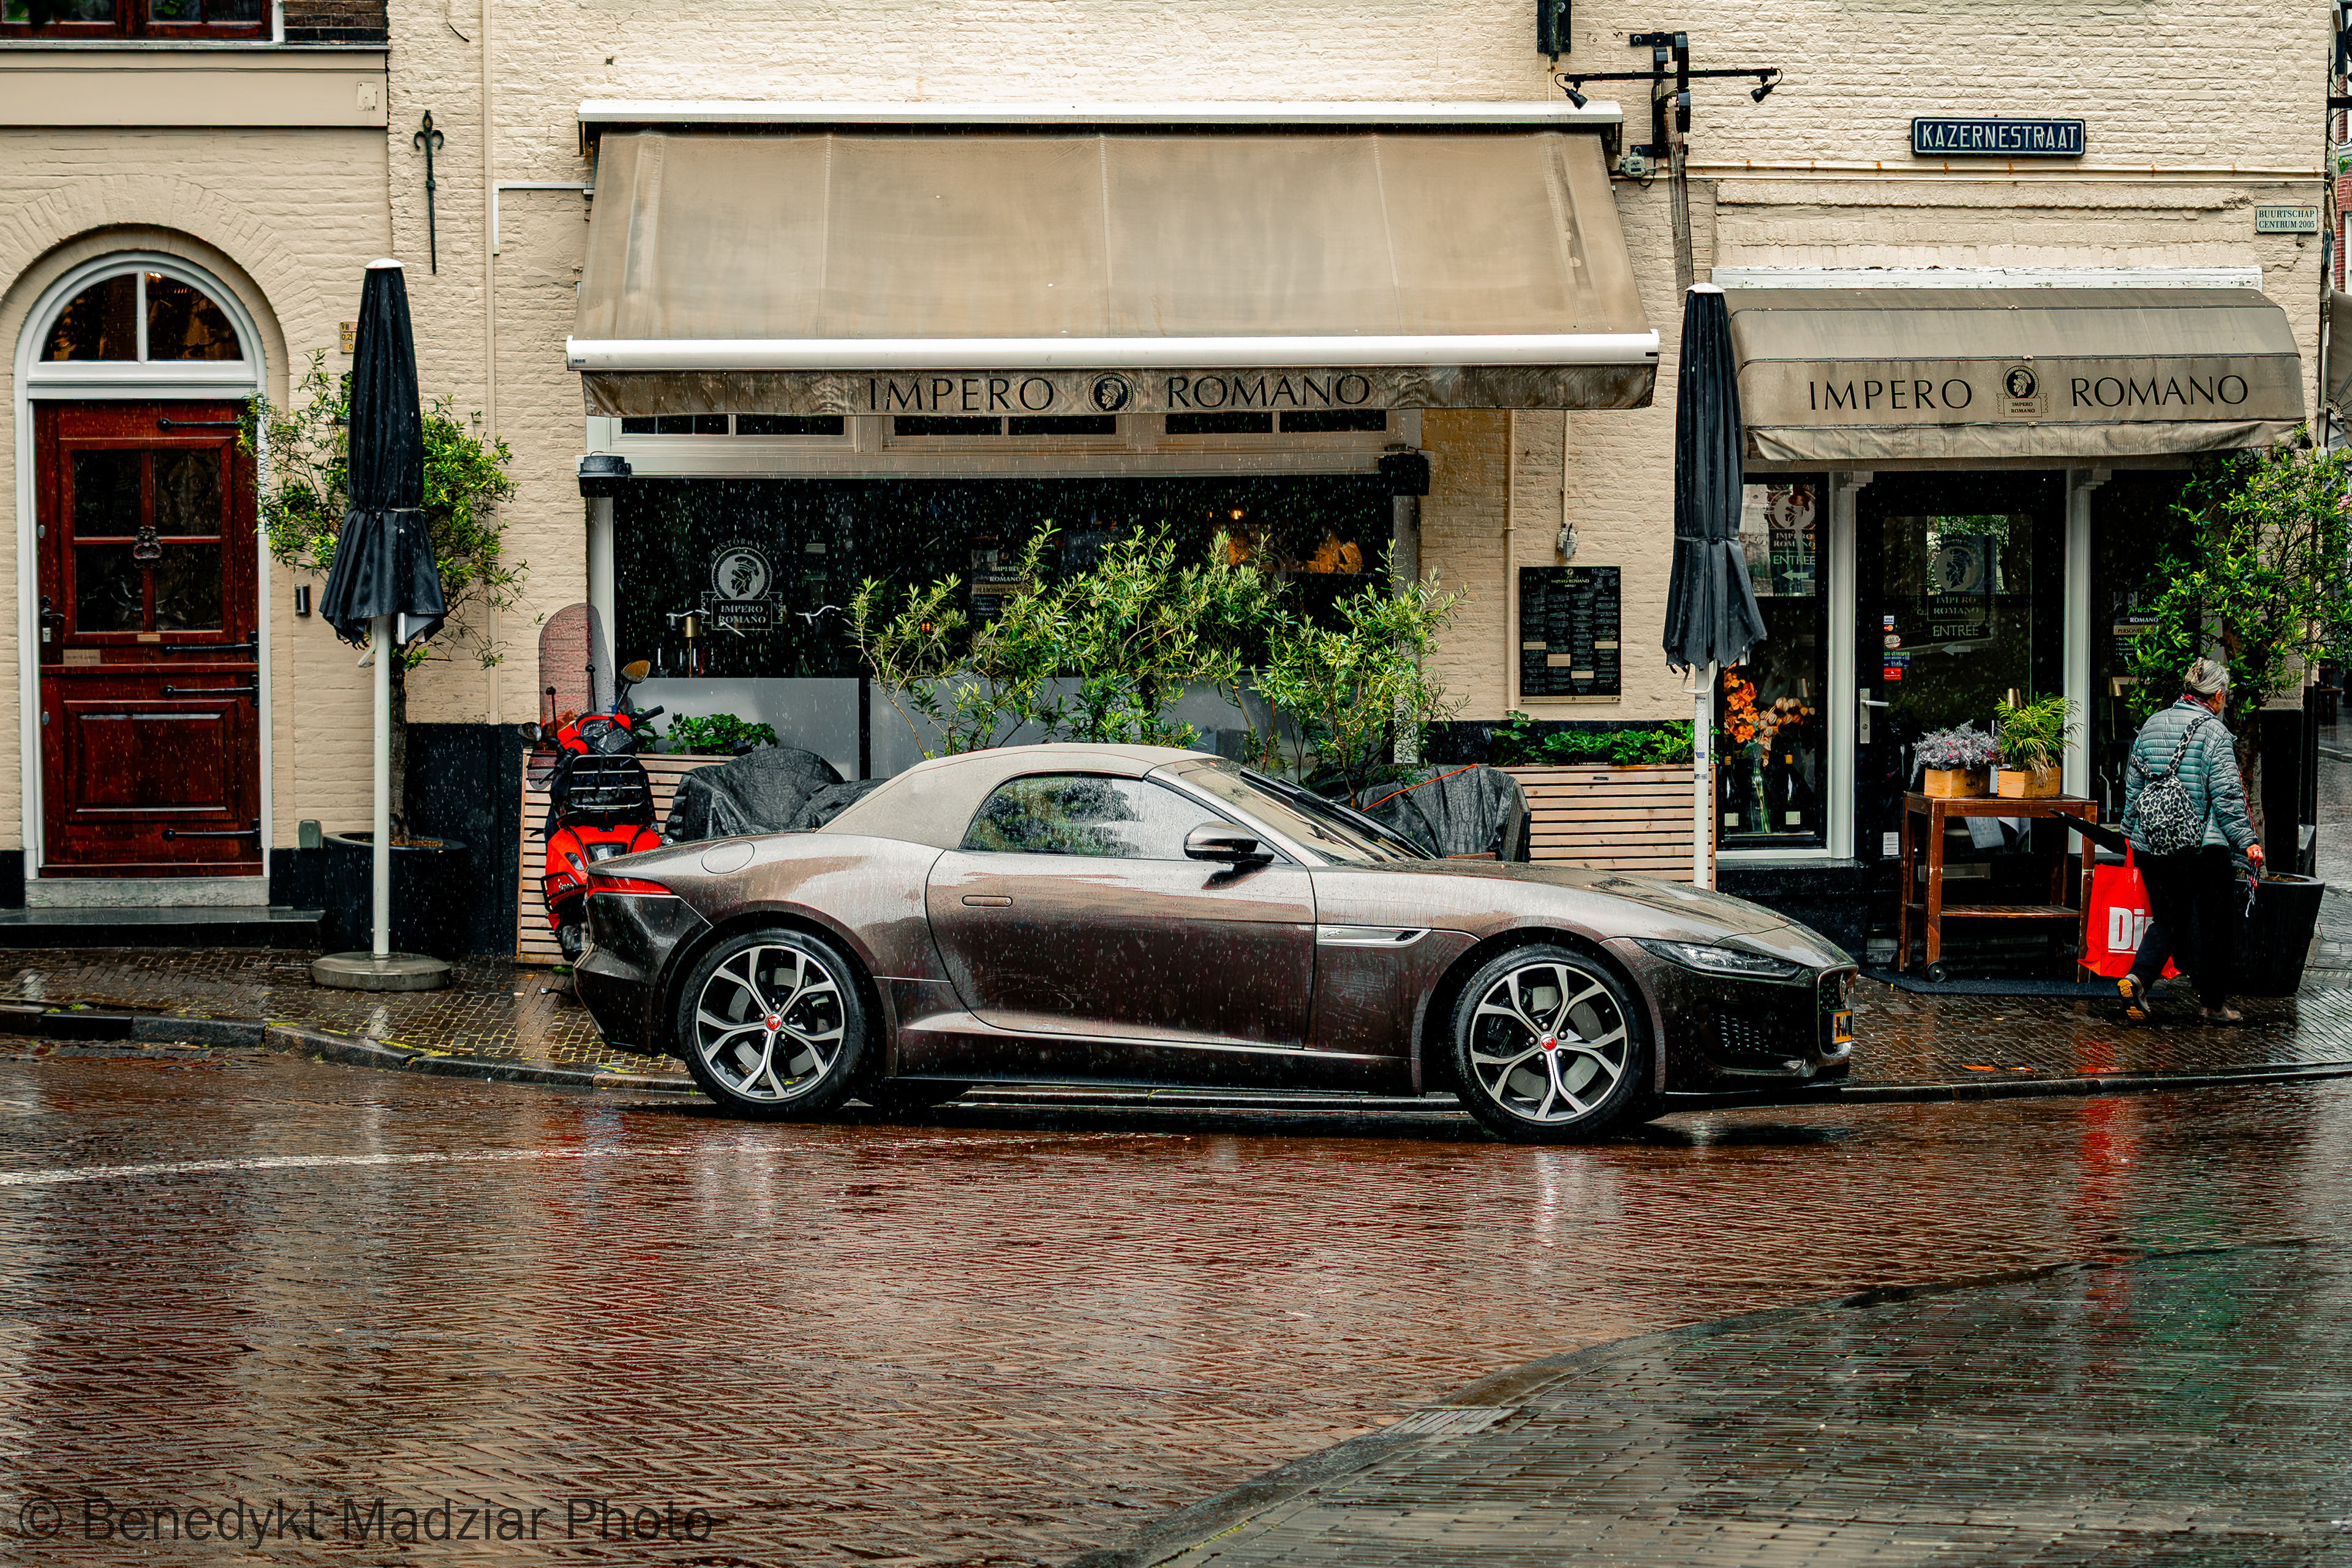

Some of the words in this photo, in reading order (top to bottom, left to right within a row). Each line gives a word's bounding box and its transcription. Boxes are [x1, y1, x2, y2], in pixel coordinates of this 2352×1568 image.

[1922, 125, 2078, 148] KAZERNESTRAAT
[870, 377, 1054, 412] IMPERO
[1167, 374, 1370, 409] ROMANO
[1809, 379, 1972, 410] IMPERO
[2070, 374, 2248, 407] ROMANO
[1773, 555, 1815, 565] ENTREE
[718, 615, 766, 624] ROMANO
[1933, 625, 1979, 637] ENTREE
[2108, 907, 2155, 951] Di
